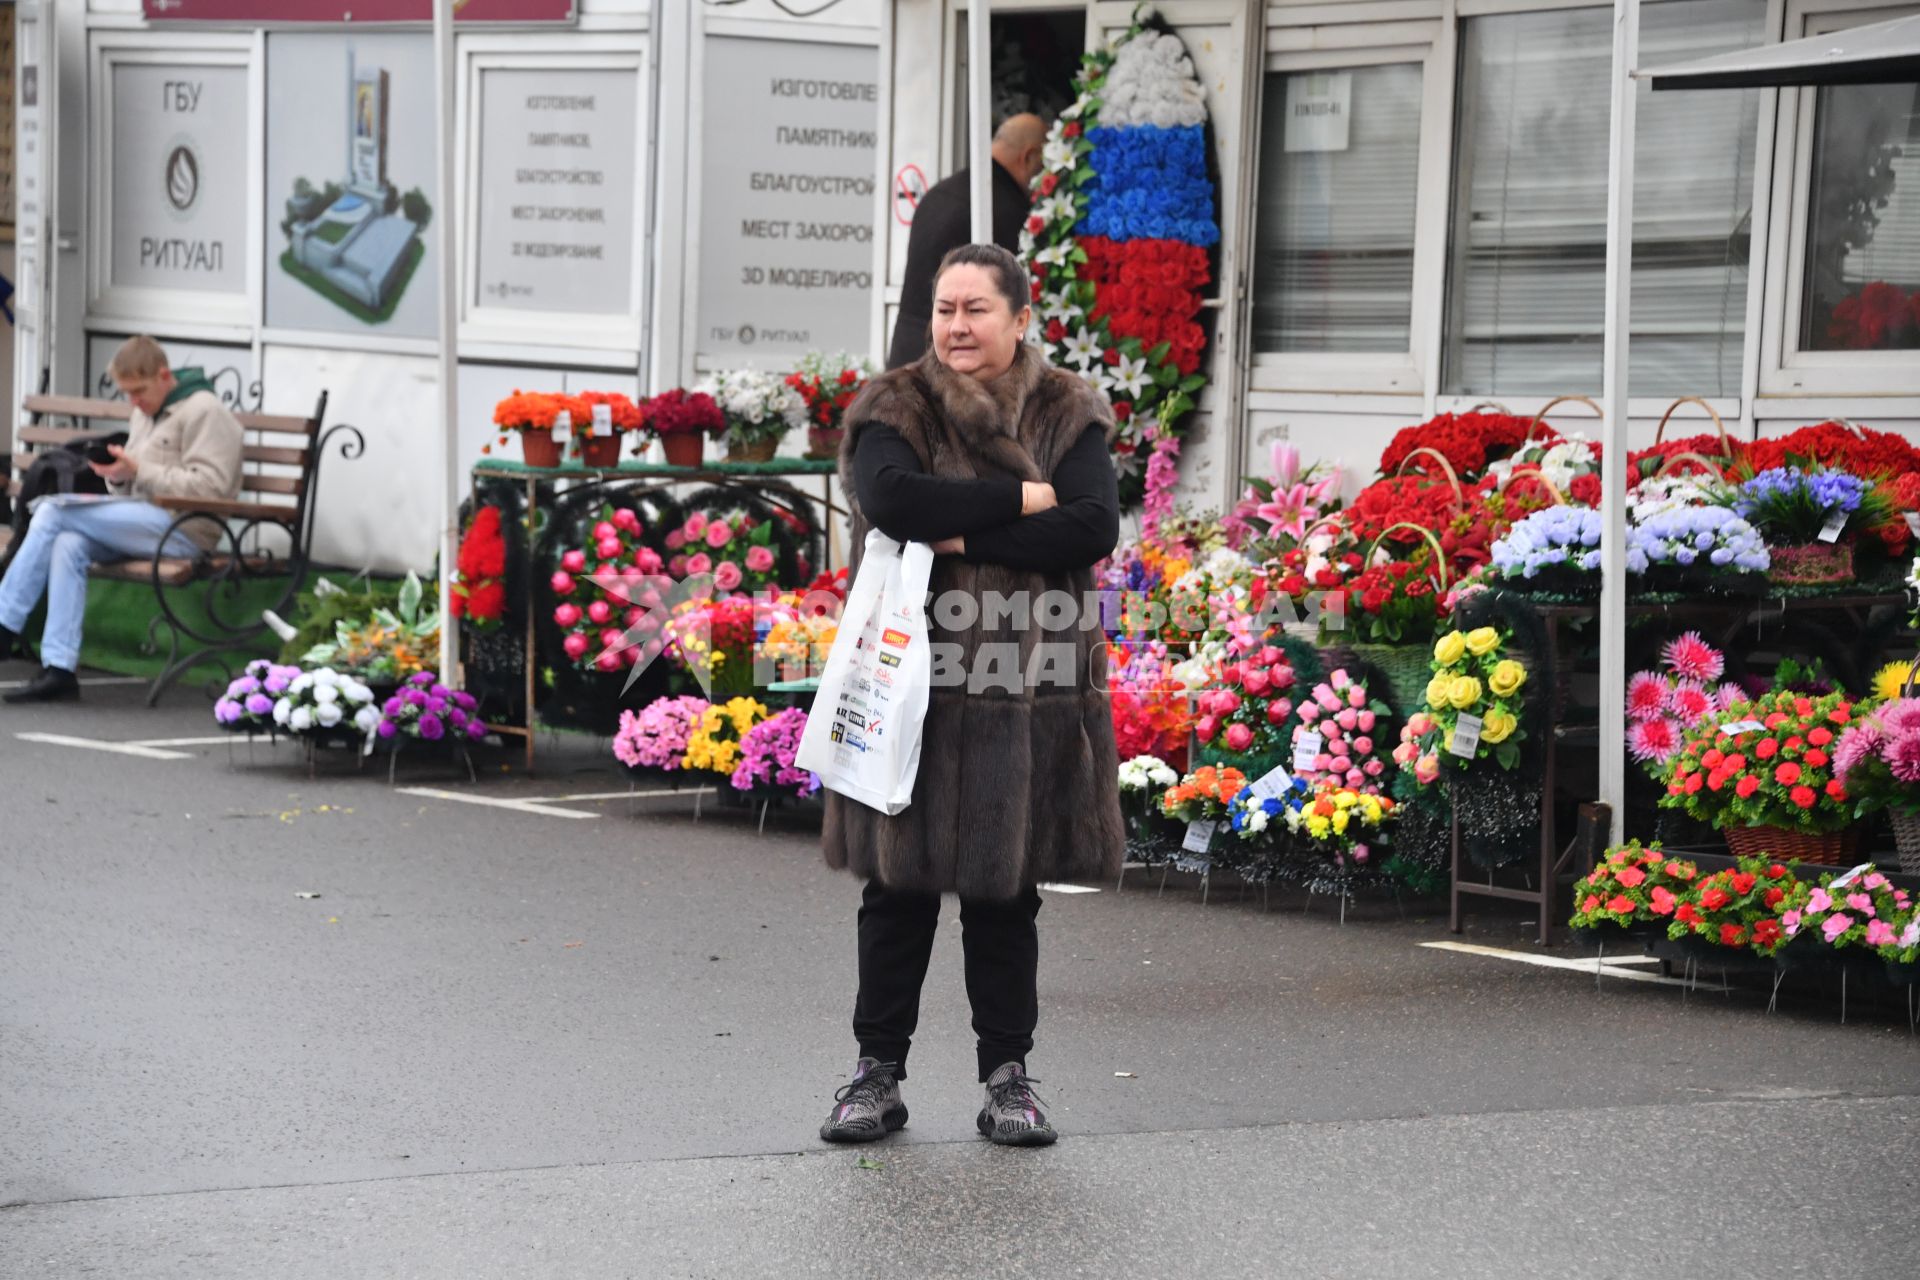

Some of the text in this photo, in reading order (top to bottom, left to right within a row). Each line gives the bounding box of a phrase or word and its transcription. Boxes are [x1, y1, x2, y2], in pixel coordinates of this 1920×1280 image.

[164, 81, 203, 112] ГБУ
[770, 78, 878, 101] ИЗГОТОВЛЕ
[741, 219, 791, 239] МЕСТ
[139, 236, 224, 271] РИТУАЛ
[742, 266, 765, 285] 3D
[711, 327, 810, 343] ГБУ РИТУАЛ
